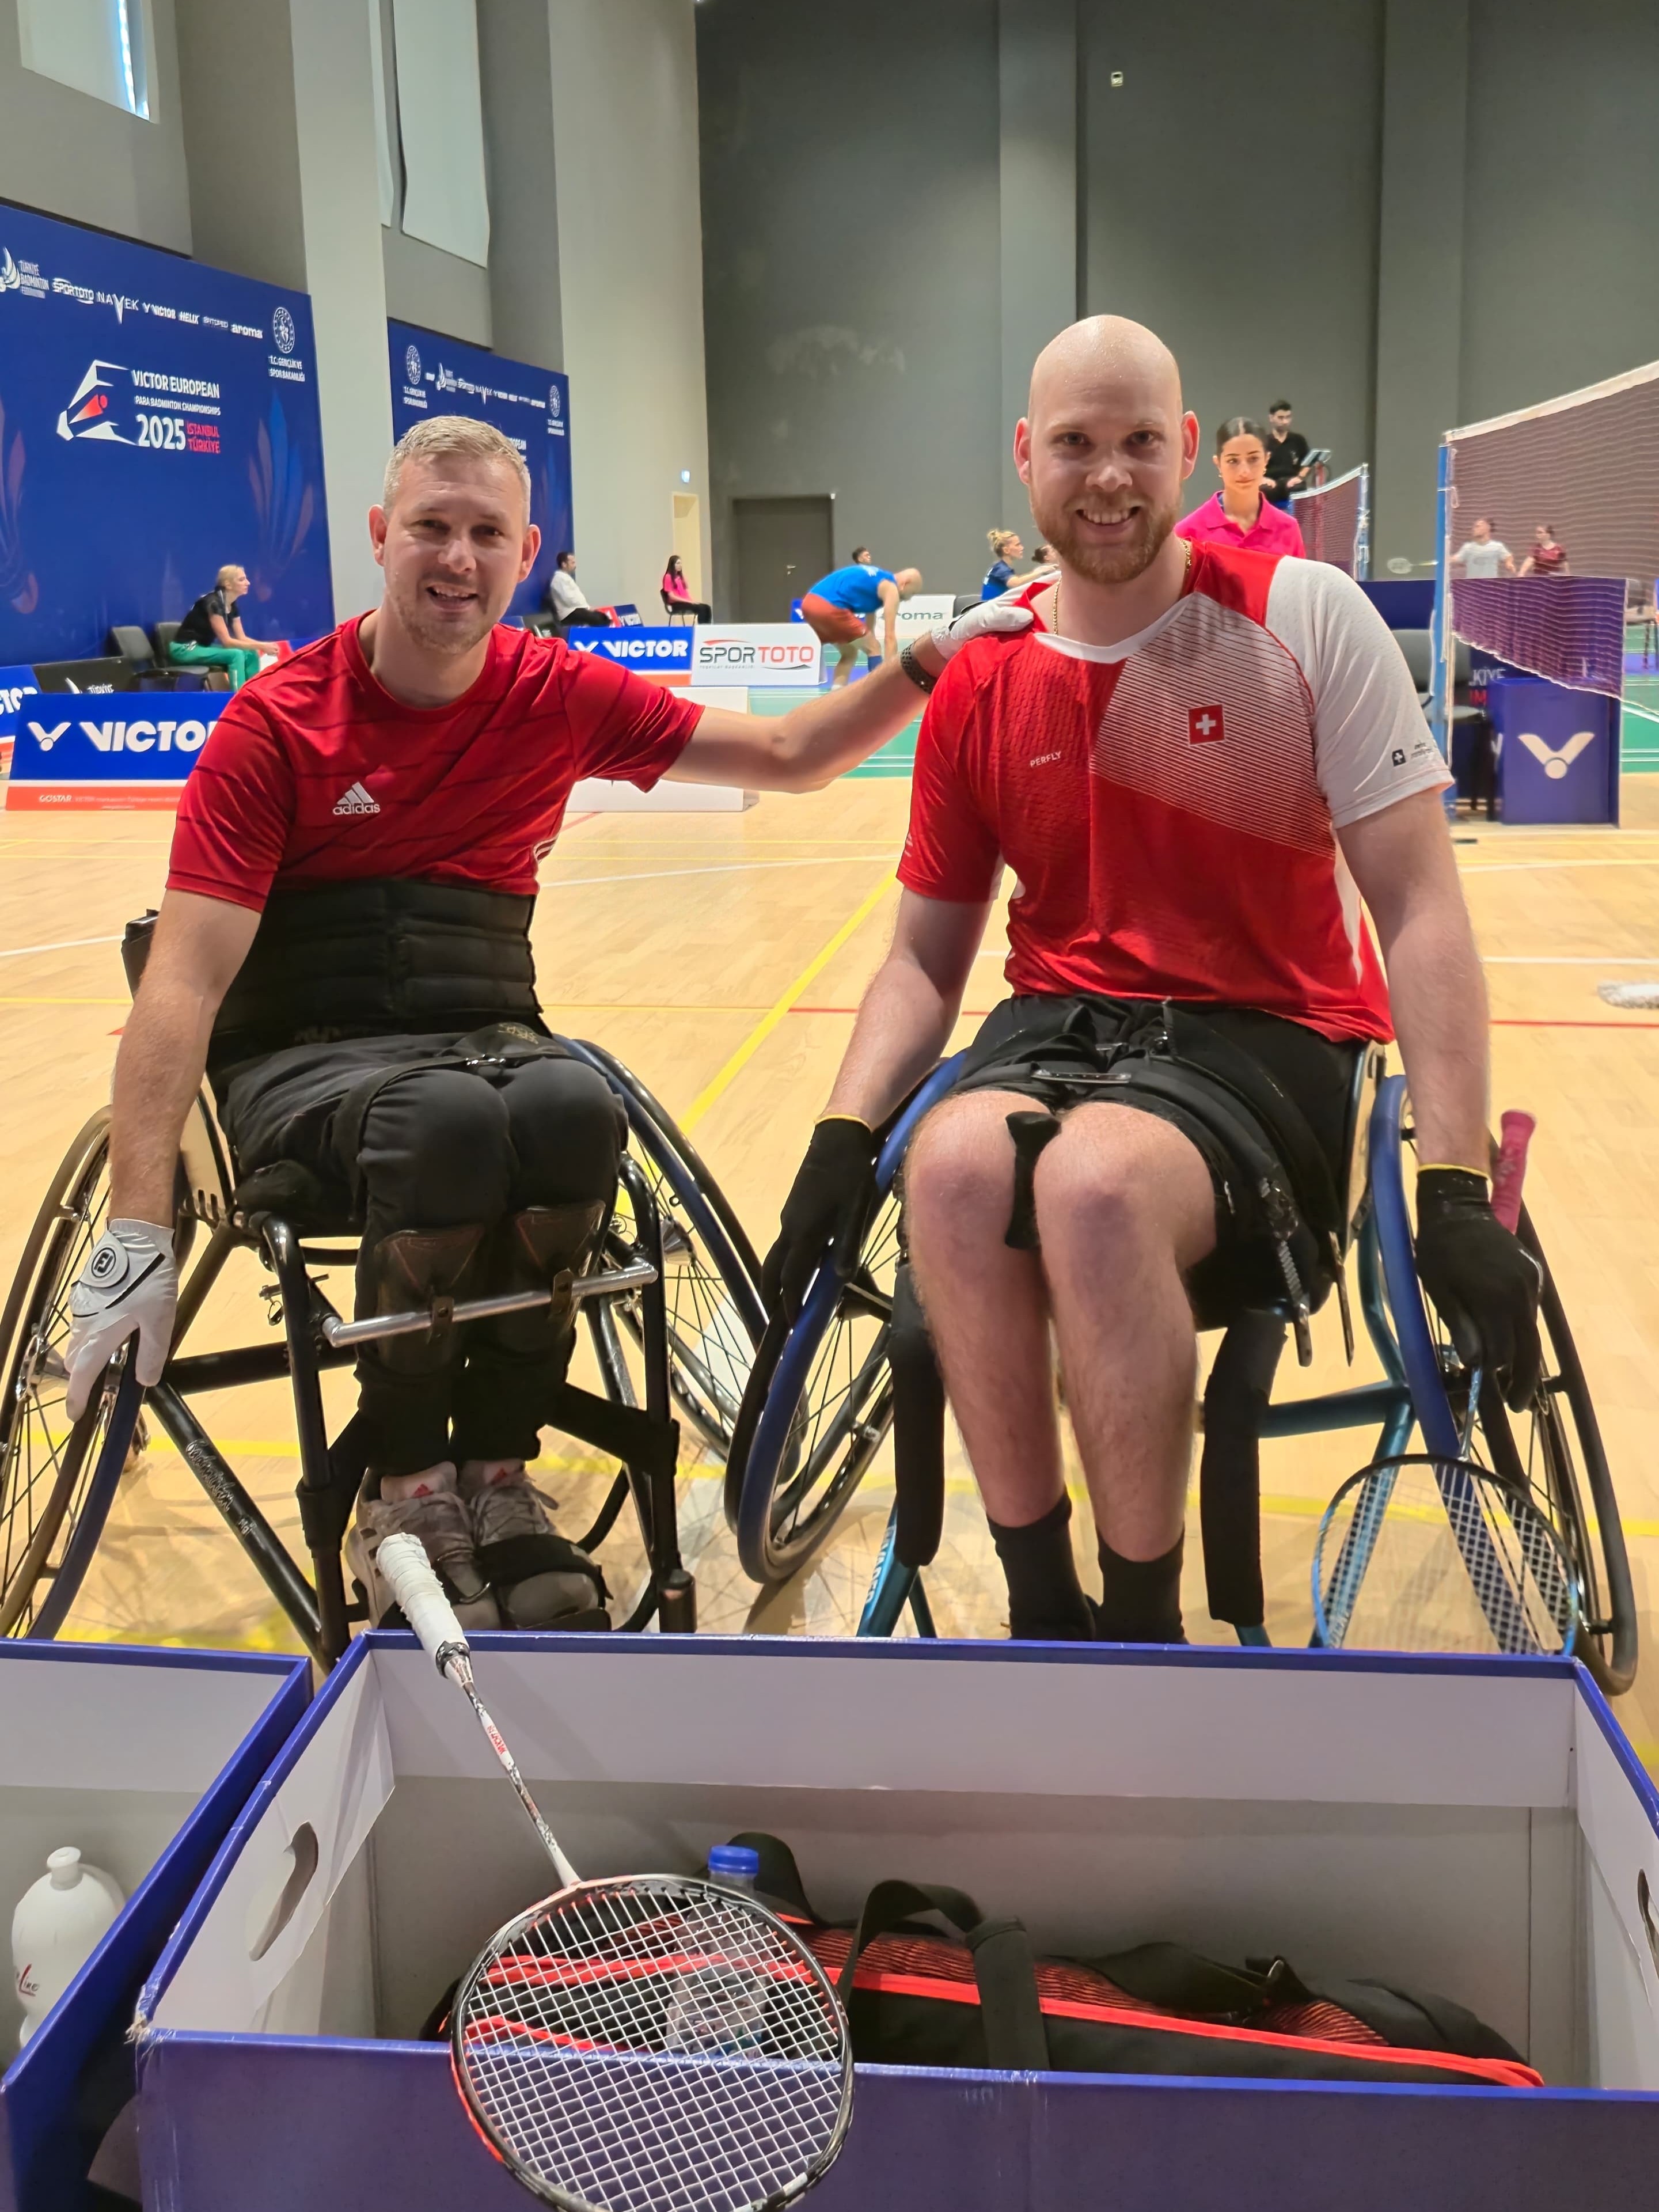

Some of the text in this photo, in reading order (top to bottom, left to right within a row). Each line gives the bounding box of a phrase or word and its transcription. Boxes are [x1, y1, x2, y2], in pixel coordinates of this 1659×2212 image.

[96, 291, 139, 324] NAVEK
[231, 323, 263, 339] aroma
[131, 370, 220, 399] VICTOR EUROPEAN
[134, 395, 221, 416] PARA BADMINTON CHAMPIONSHIPS
[135, 413, 186, 450] 2025
[602, 640, 688, 658] VICTOR
[1030, 751, 1061, 767] PERFLY
[333, 802, 380, 815] adidas
